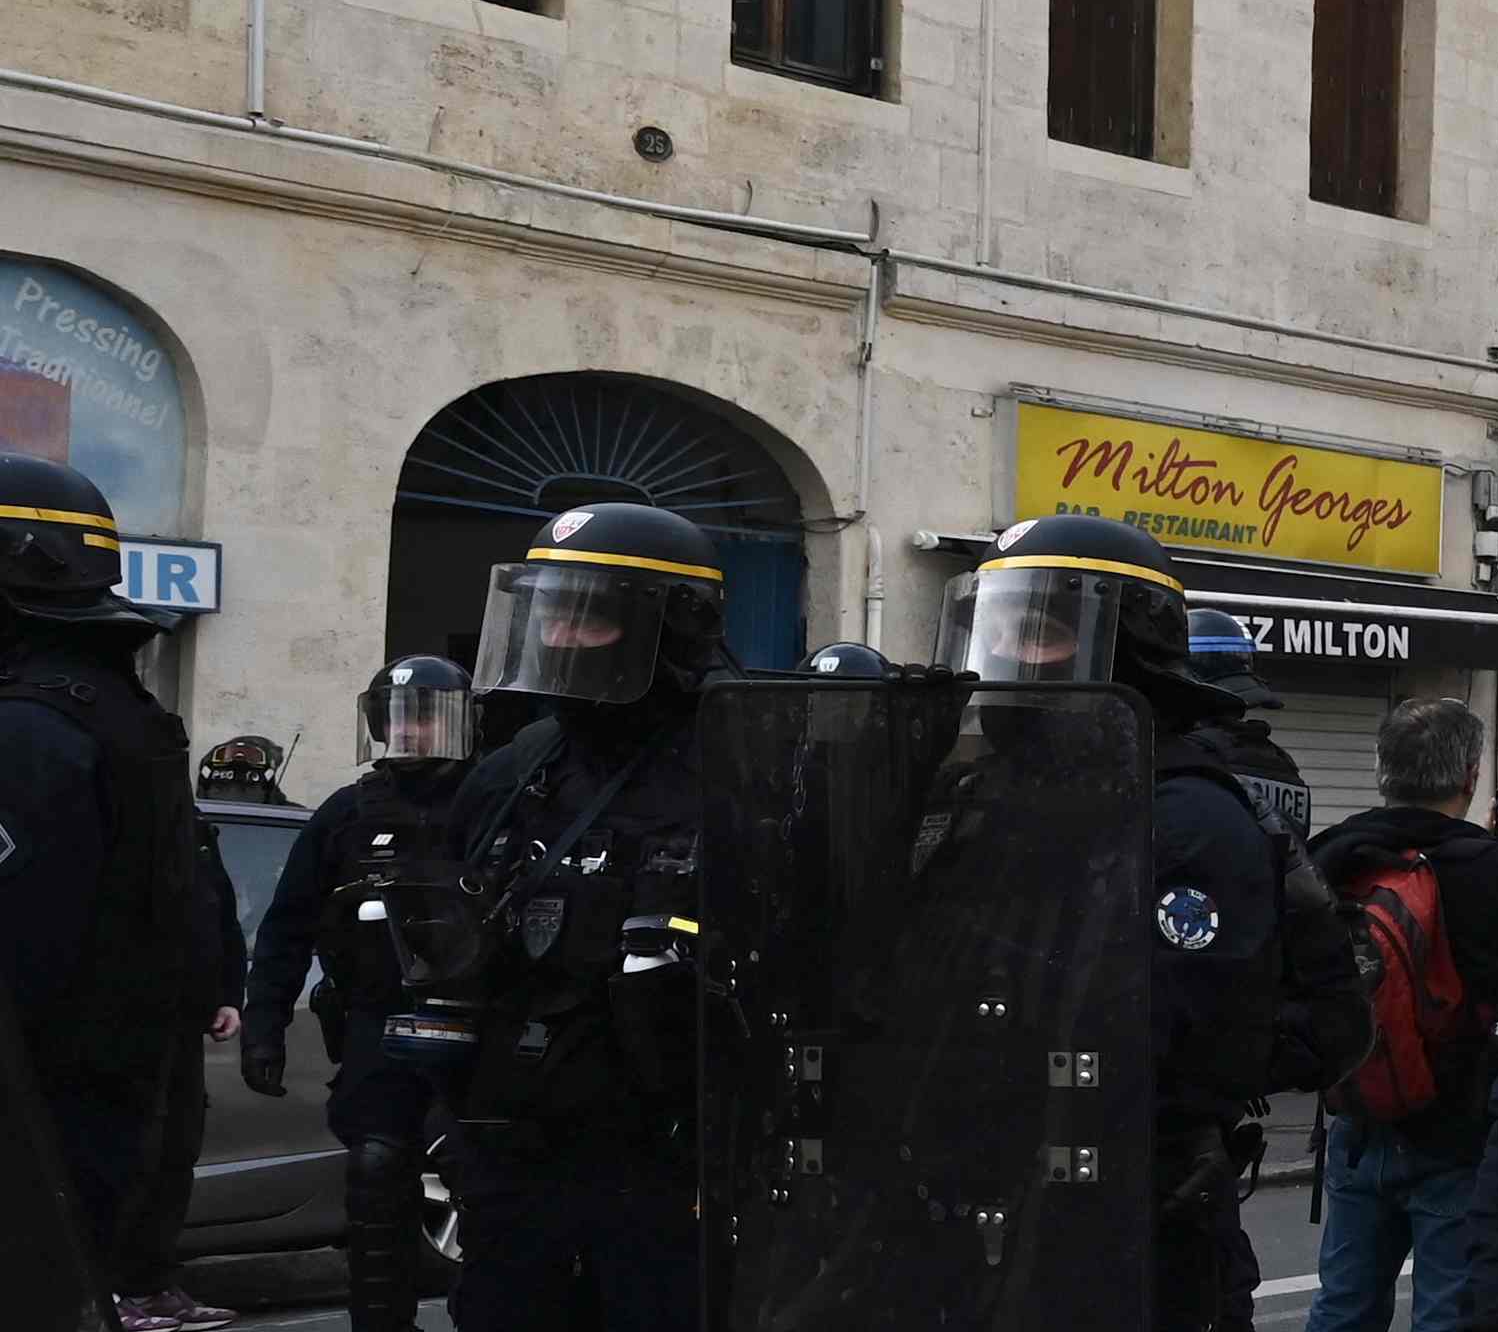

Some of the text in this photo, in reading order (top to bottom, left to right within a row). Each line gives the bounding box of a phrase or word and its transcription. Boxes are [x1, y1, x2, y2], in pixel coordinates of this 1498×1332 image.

[0, 325, 169, 430] Traditionnel
[15, 277, 162, 382] Pressing
[1056, 437, 1412, 551] Milton Georges
[1122, 510, 1258, 545] RESTAURANT
[1283, 618, 1409, 660] MILTON
